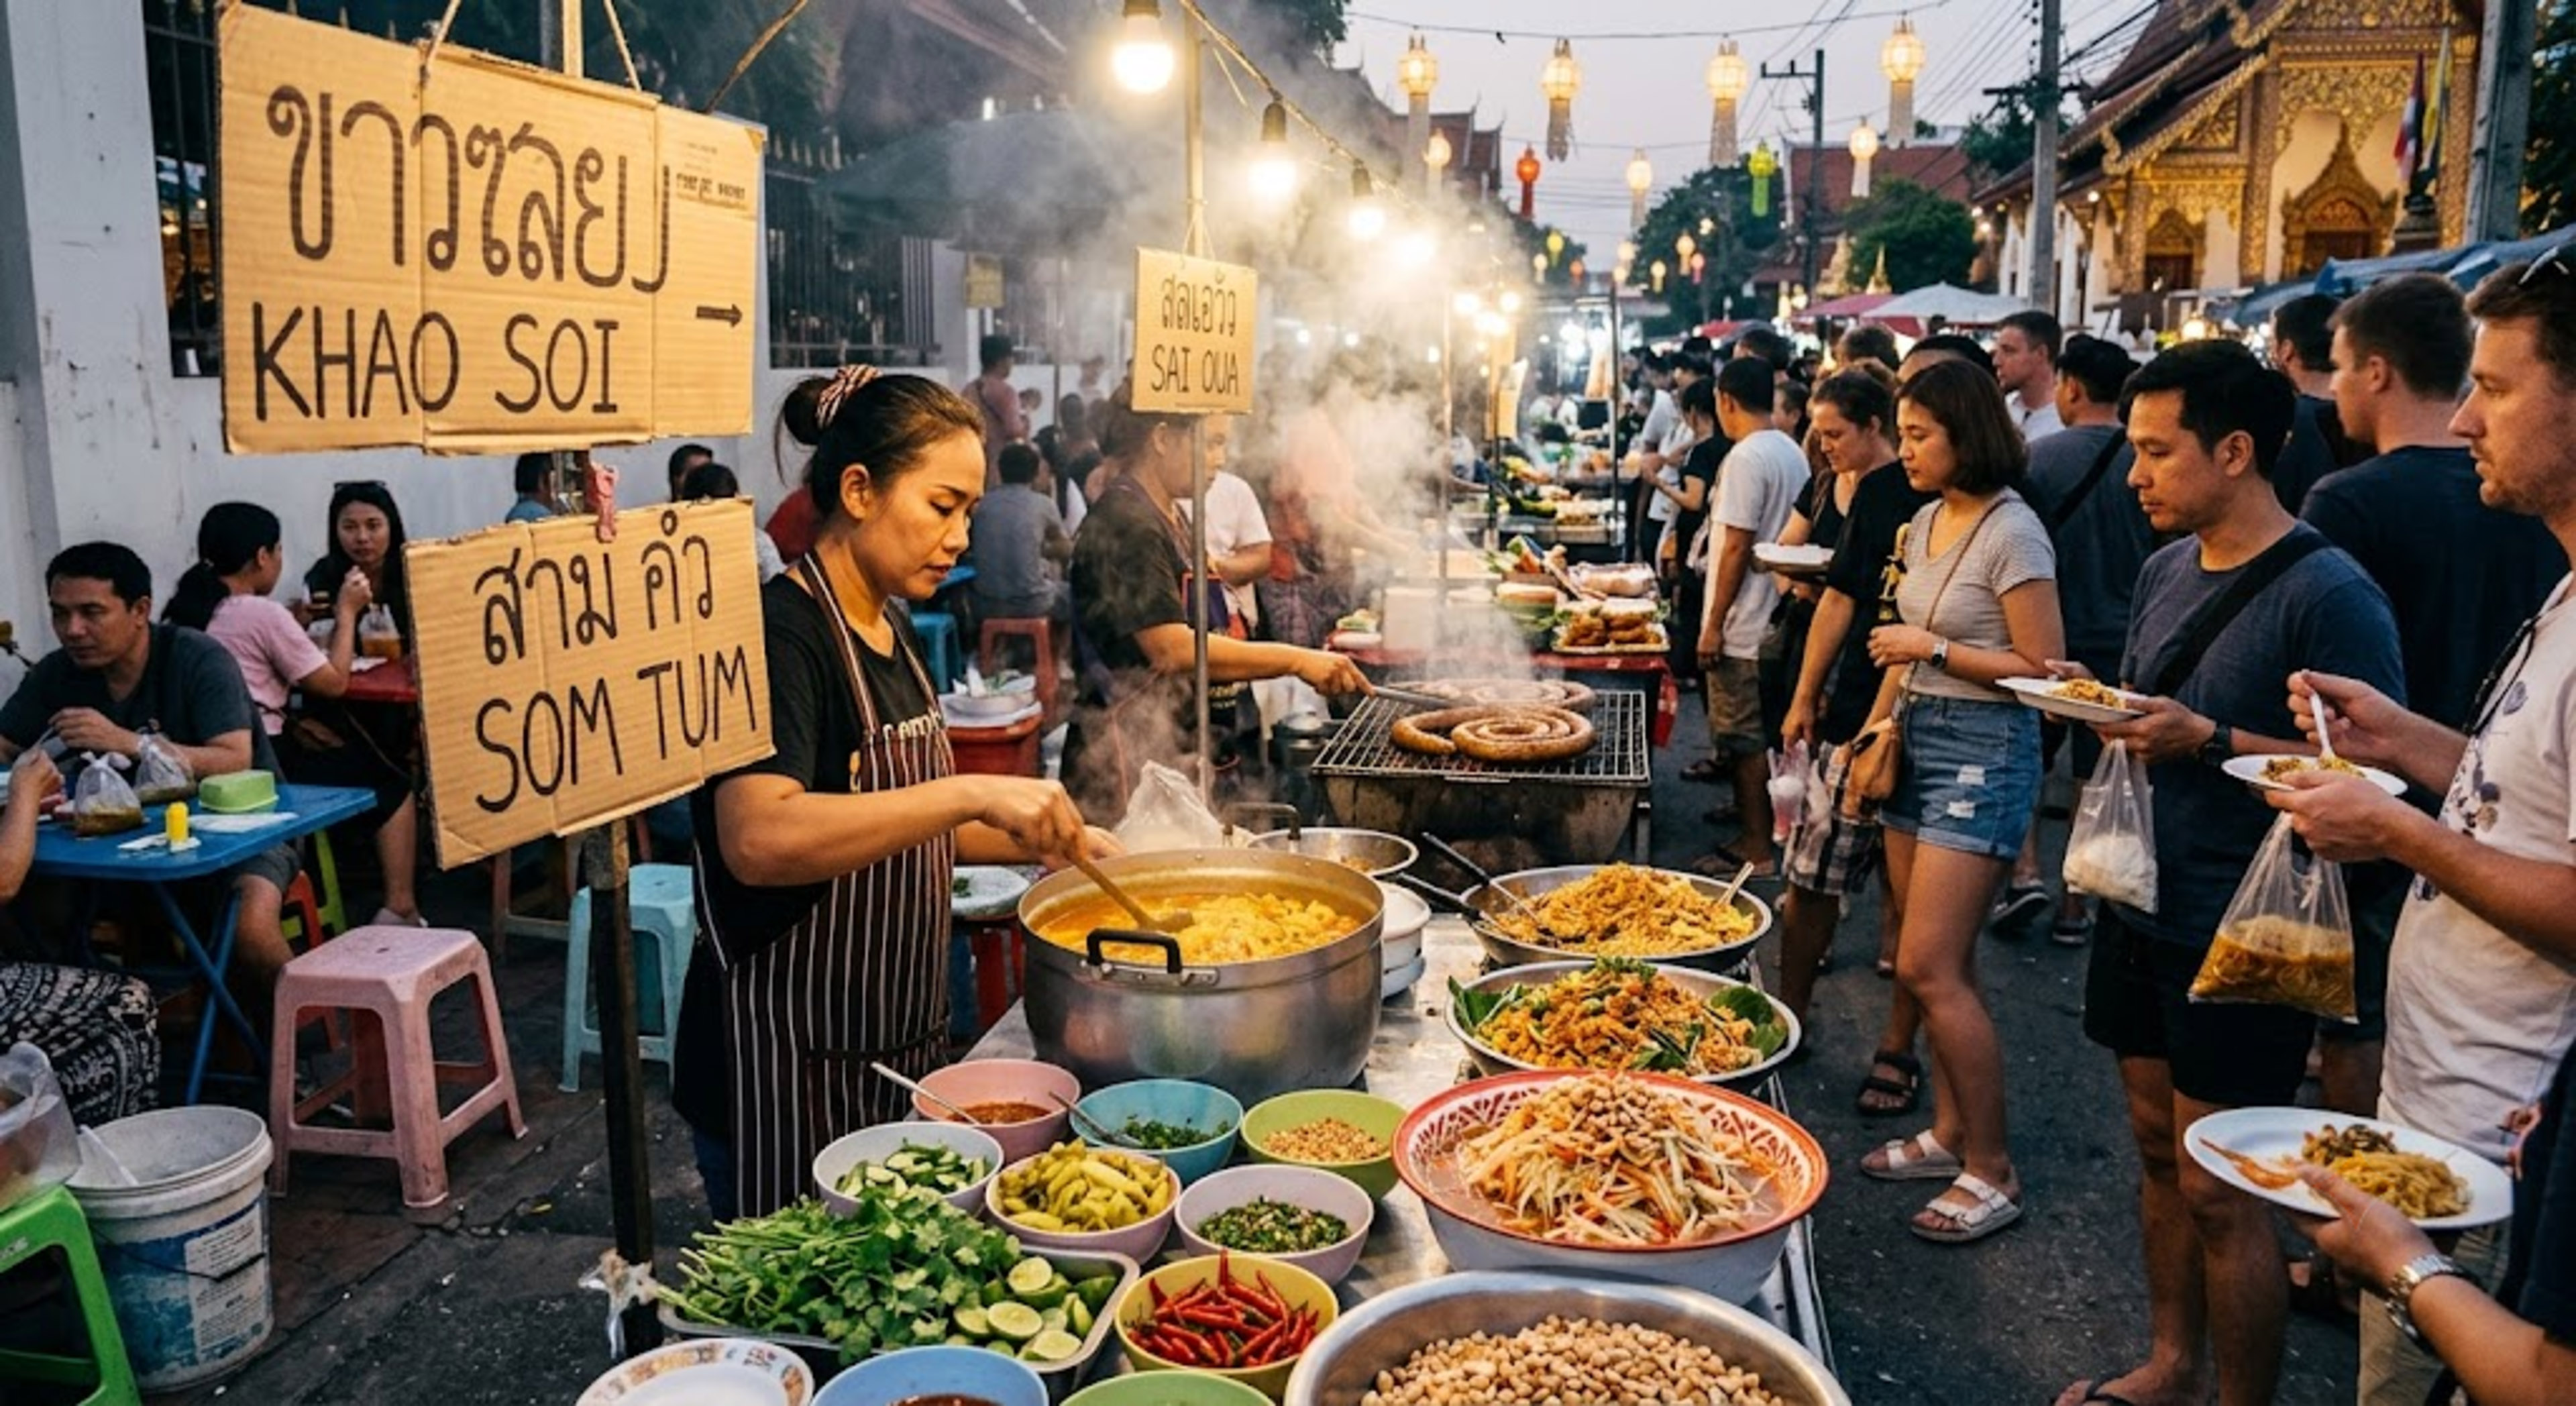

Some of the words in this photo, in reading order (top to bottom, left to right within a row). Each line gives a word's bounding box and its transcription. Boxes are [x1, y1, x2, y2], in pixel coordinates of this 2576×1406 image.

[253, 301, 460, 422] KHAO
[494, 313, 619, 414] SOI
[1150, 343, 1191, 393] SAI
[1201, 349, 1240, 396] OUA
[475, 677, 623, 813] SOM
[636, 645, 757, 760] TUM
